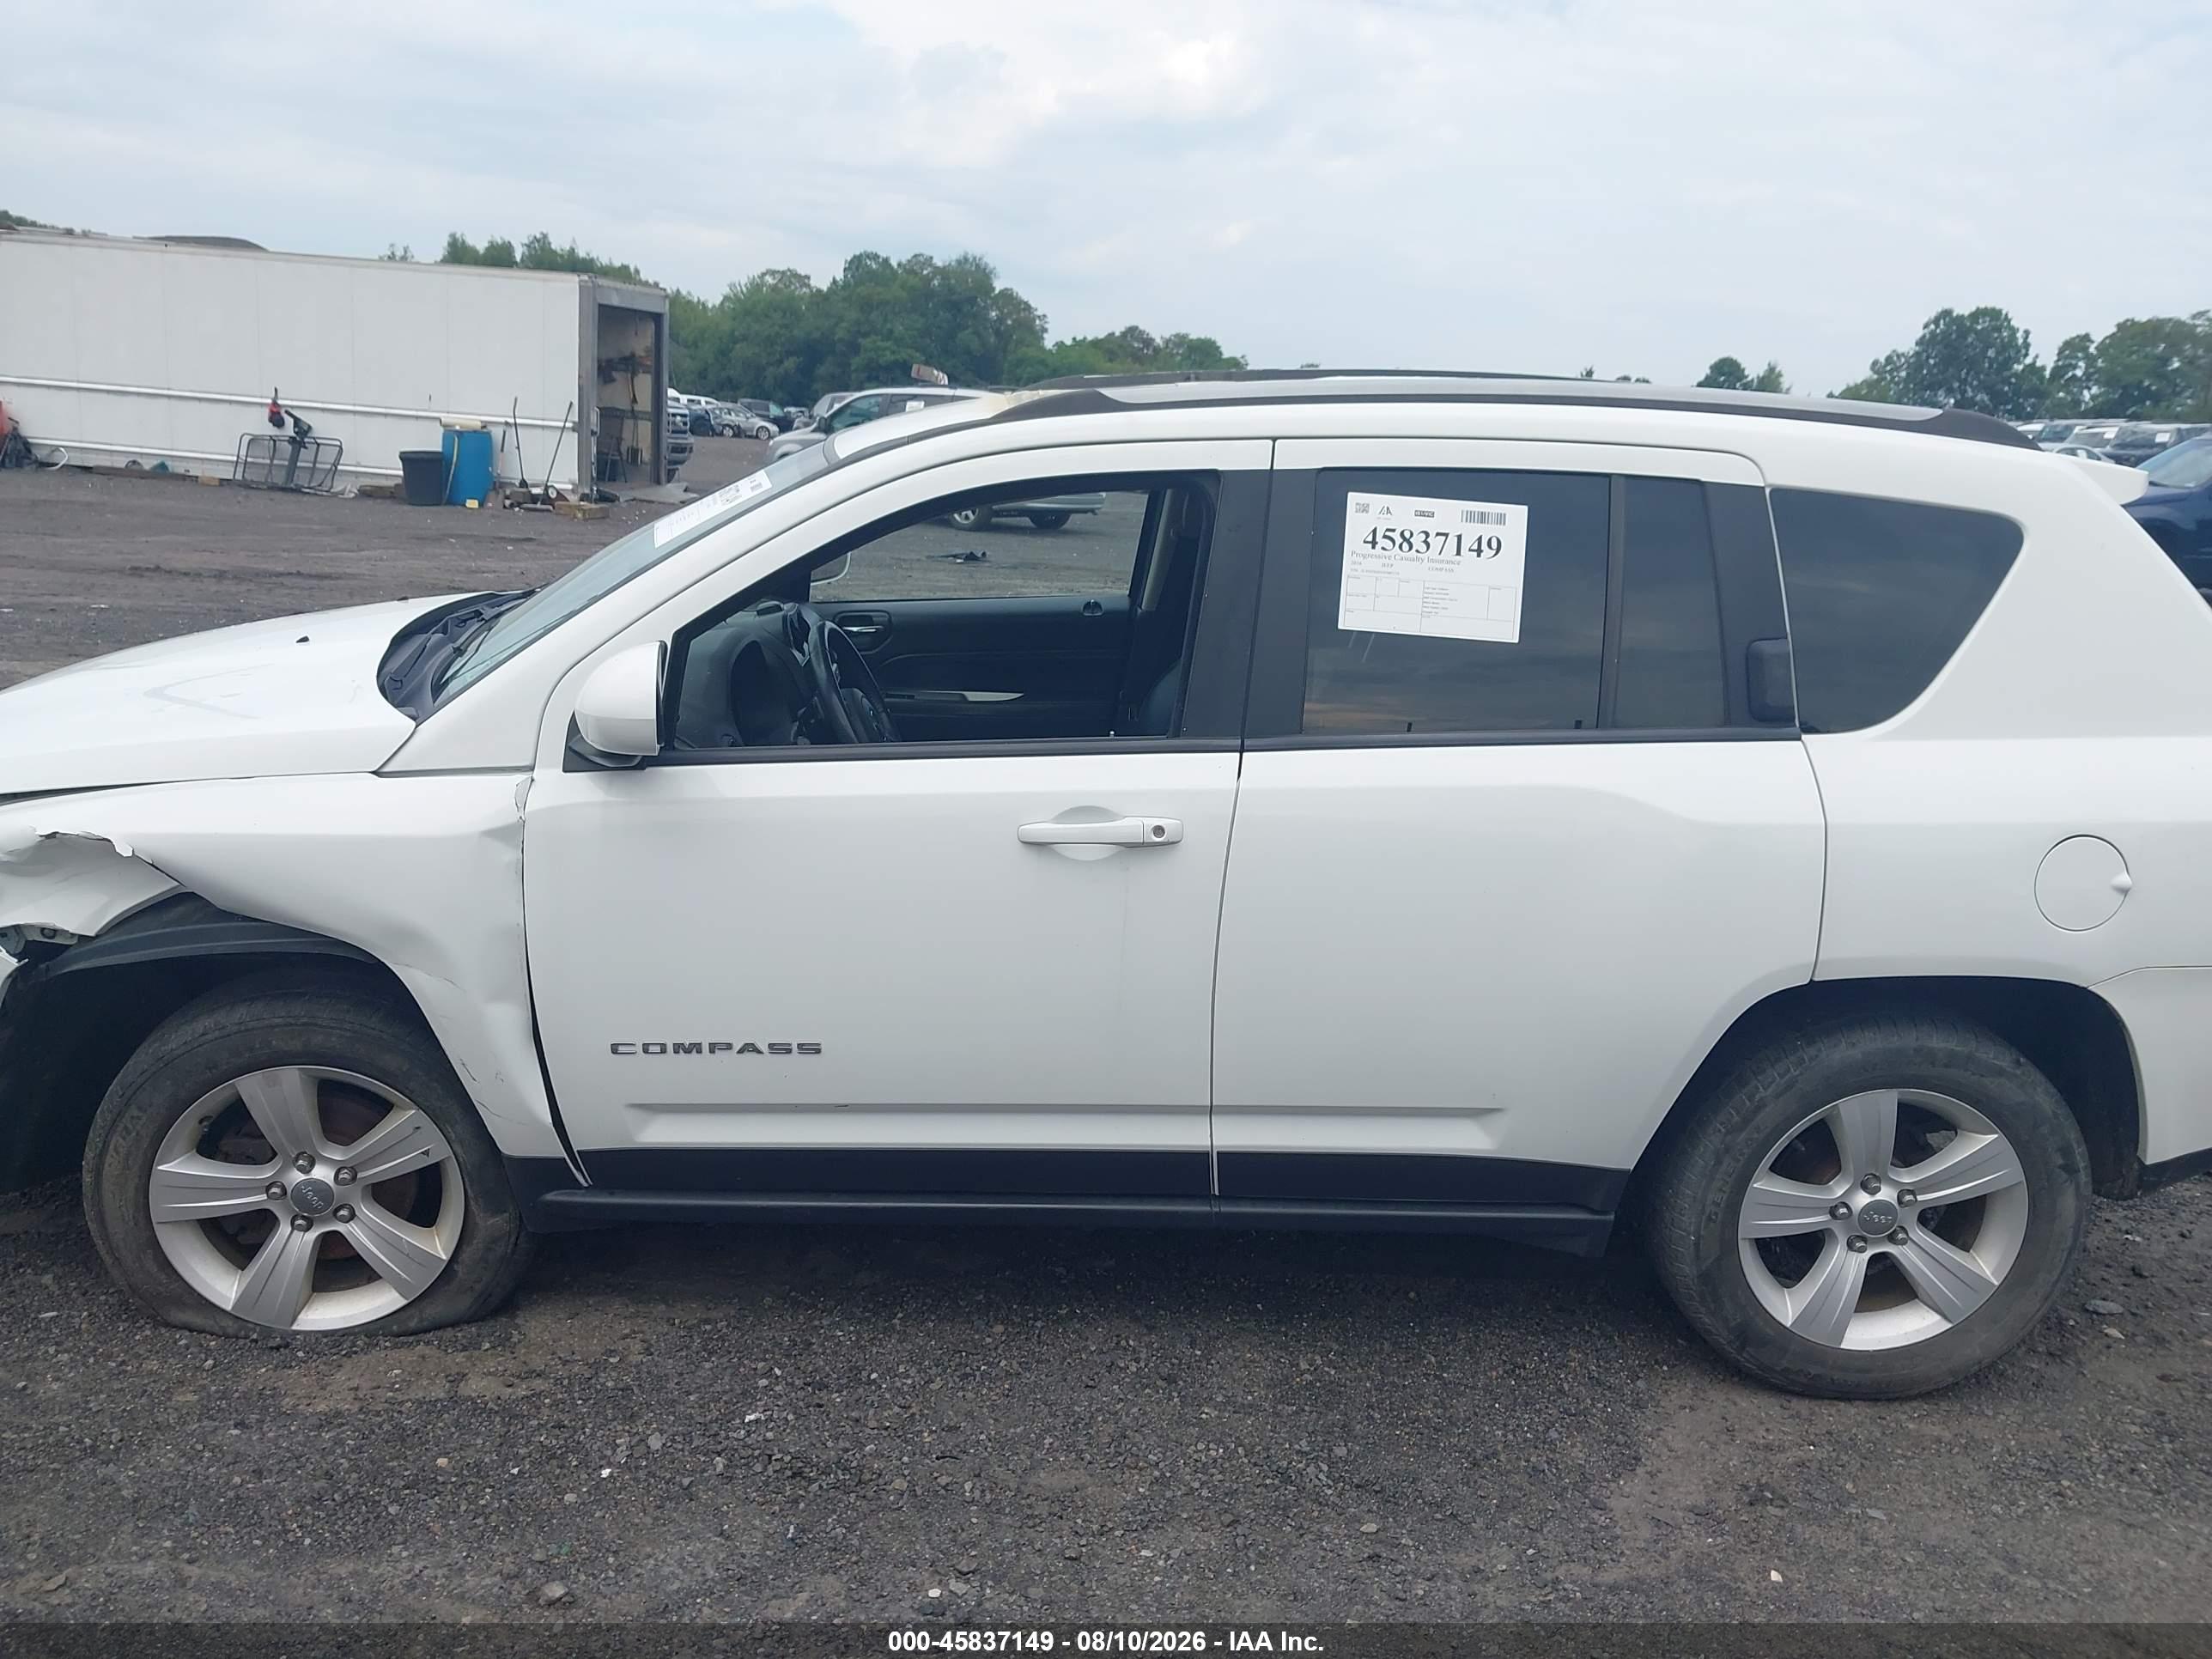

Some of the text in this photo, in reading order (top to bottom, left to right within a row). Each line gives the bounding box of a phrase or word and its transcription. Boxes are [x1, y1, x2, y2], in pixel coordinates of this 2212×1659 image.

[1363, 526, 1503, 560] 45837149
[1351, 550, 1462, 566] Progressive Casualty Insurance
[610, 1041, 822, 1055] COMPASS
[301, 1185, 324, 1209] Jeep
